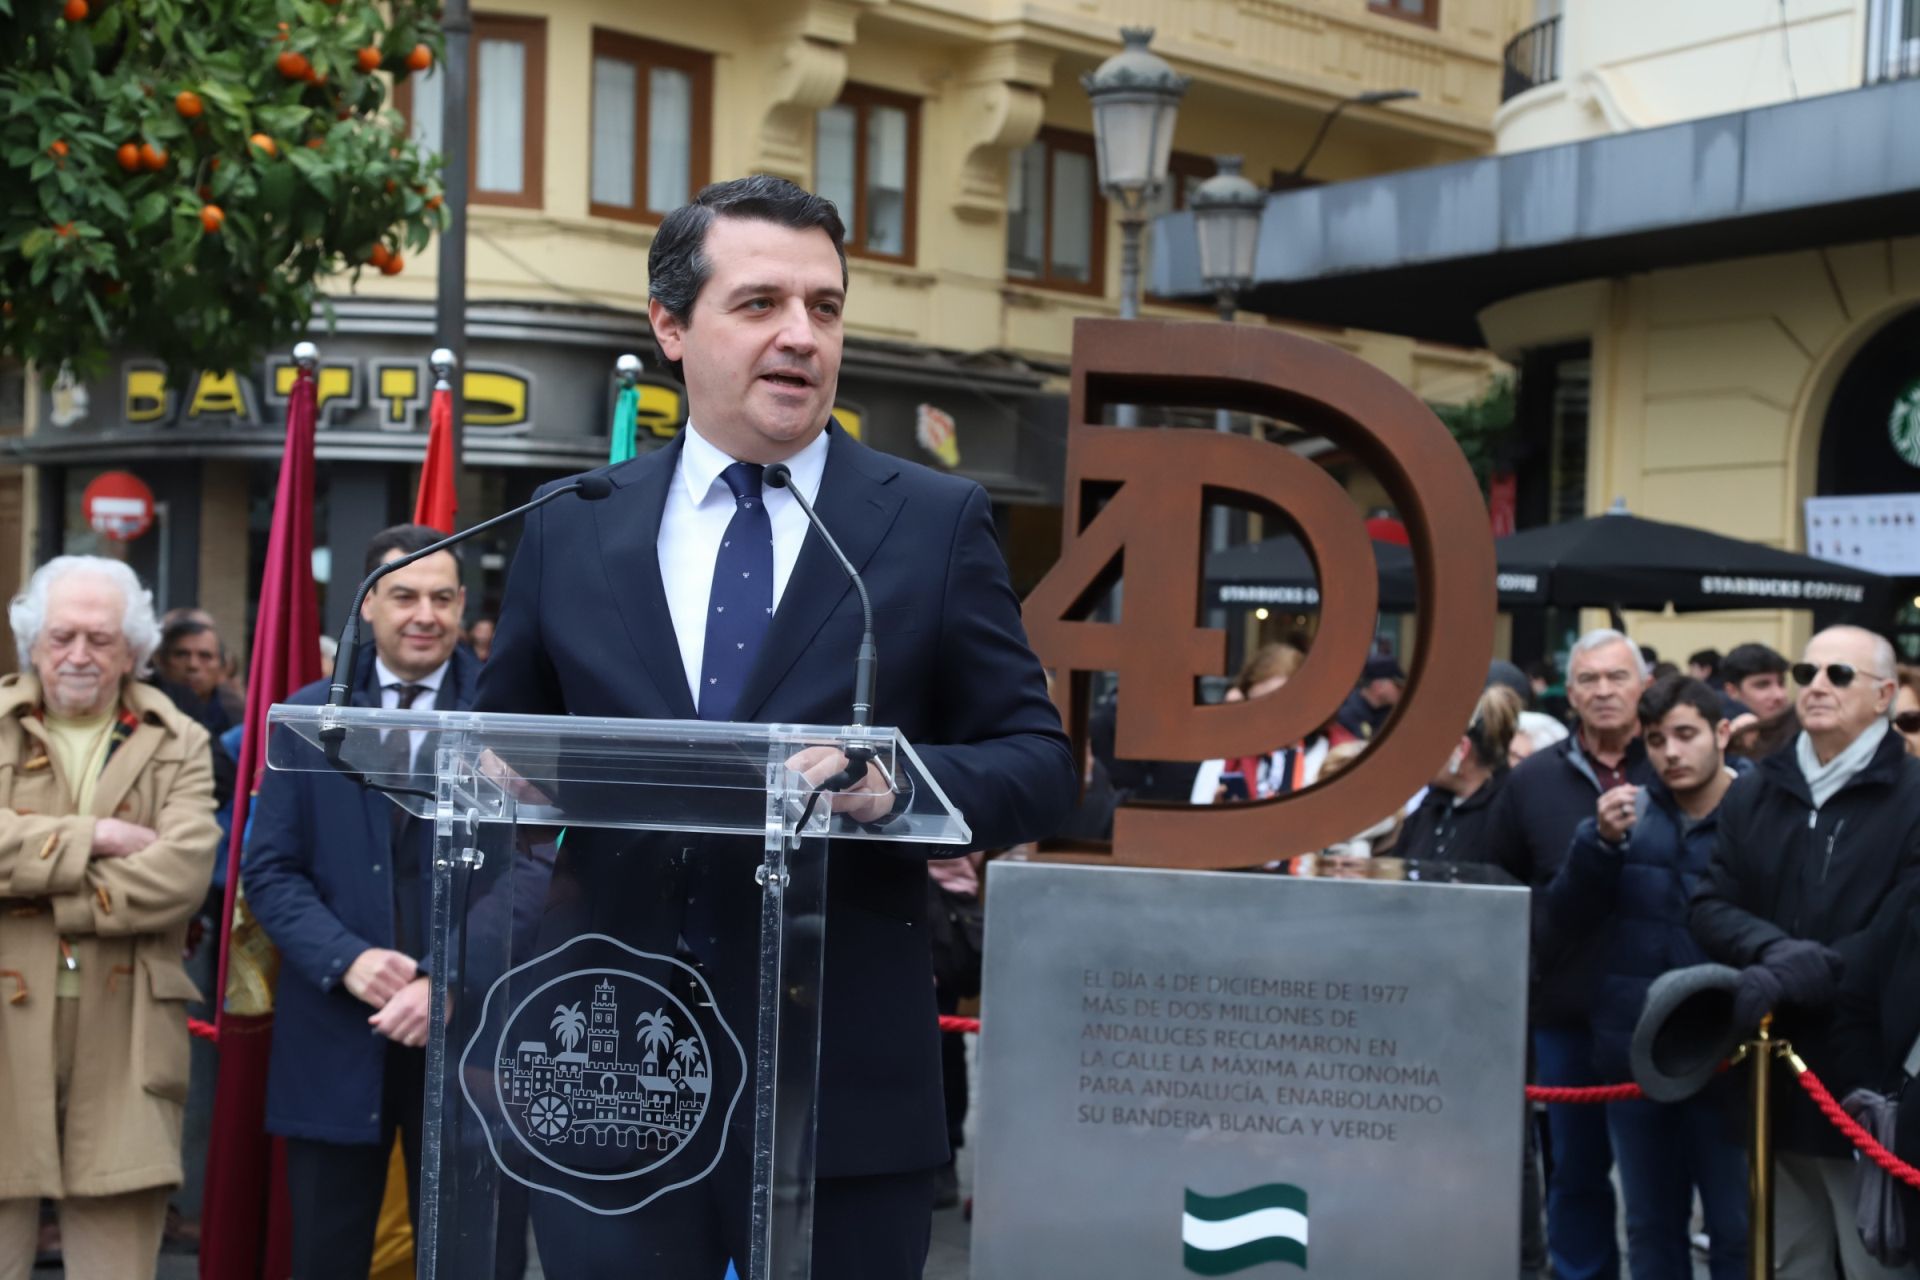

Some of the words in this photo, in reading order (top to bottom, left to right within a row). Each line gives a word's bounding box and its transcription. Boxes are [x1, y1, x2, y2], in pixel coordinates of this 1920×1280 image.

[1219, 585, 1303, 604] STARBUCKS
[1700, 575, 1801, 598] STARBUCKS
[1803, 580, 1864, 602] COFFEE
[1084, 969, 1103, 988] EL
[1112, 970, 1147, 991] DÍA
[1154, 974, 1166, 991] 4
[1174, 974, 1199, 993] DE
[1207, 976, 1317, 1000] DICIEMBRE
[1325, 982, 1352, 1002] DE
[1361, 984, 1409, 1003] 1977
[1082, 994, 1126, 1016] MÁS
[1134, 998, 1160, 1018] DE
[1167, 1001, 1212, 1020] DOS
[1220, 1003, 1324, 1027] MILLONES
[1331, 1008, 1358, 1028] DE
[1081, 1023, 1207, 1047] ANDALUCES
[1214, 1029, 1361, 1055] RECLAMARON
[1368, 1038, 1396, 1057] EN
[1080, 1051, 1103, 1067] LA
[1111, 1050, 1173, 1072] CALLE
[1180, 1054, 1203, 1073] LA
[1212, 1054, 1298, 1078] MÁXIMA
[1305, 1061, 1441, 1086] AUTONOMÍA
[1079, 1076, 1133, 1095] PARA
[1141, 1078, 1269, 1105] ANDALUCÍA,
[1278, 1086, 1443, 1114] ENARBOLANDO
[1077, 1104, 1104, 1124] SU
[1113, 1106, 1211, 1129] BANDERA
[1219, 1112, 1303, 1135] BLANCA
[1310, 1118, 1323, 1136] Y
[1330, 1120, 1397, 1142] VERDE
